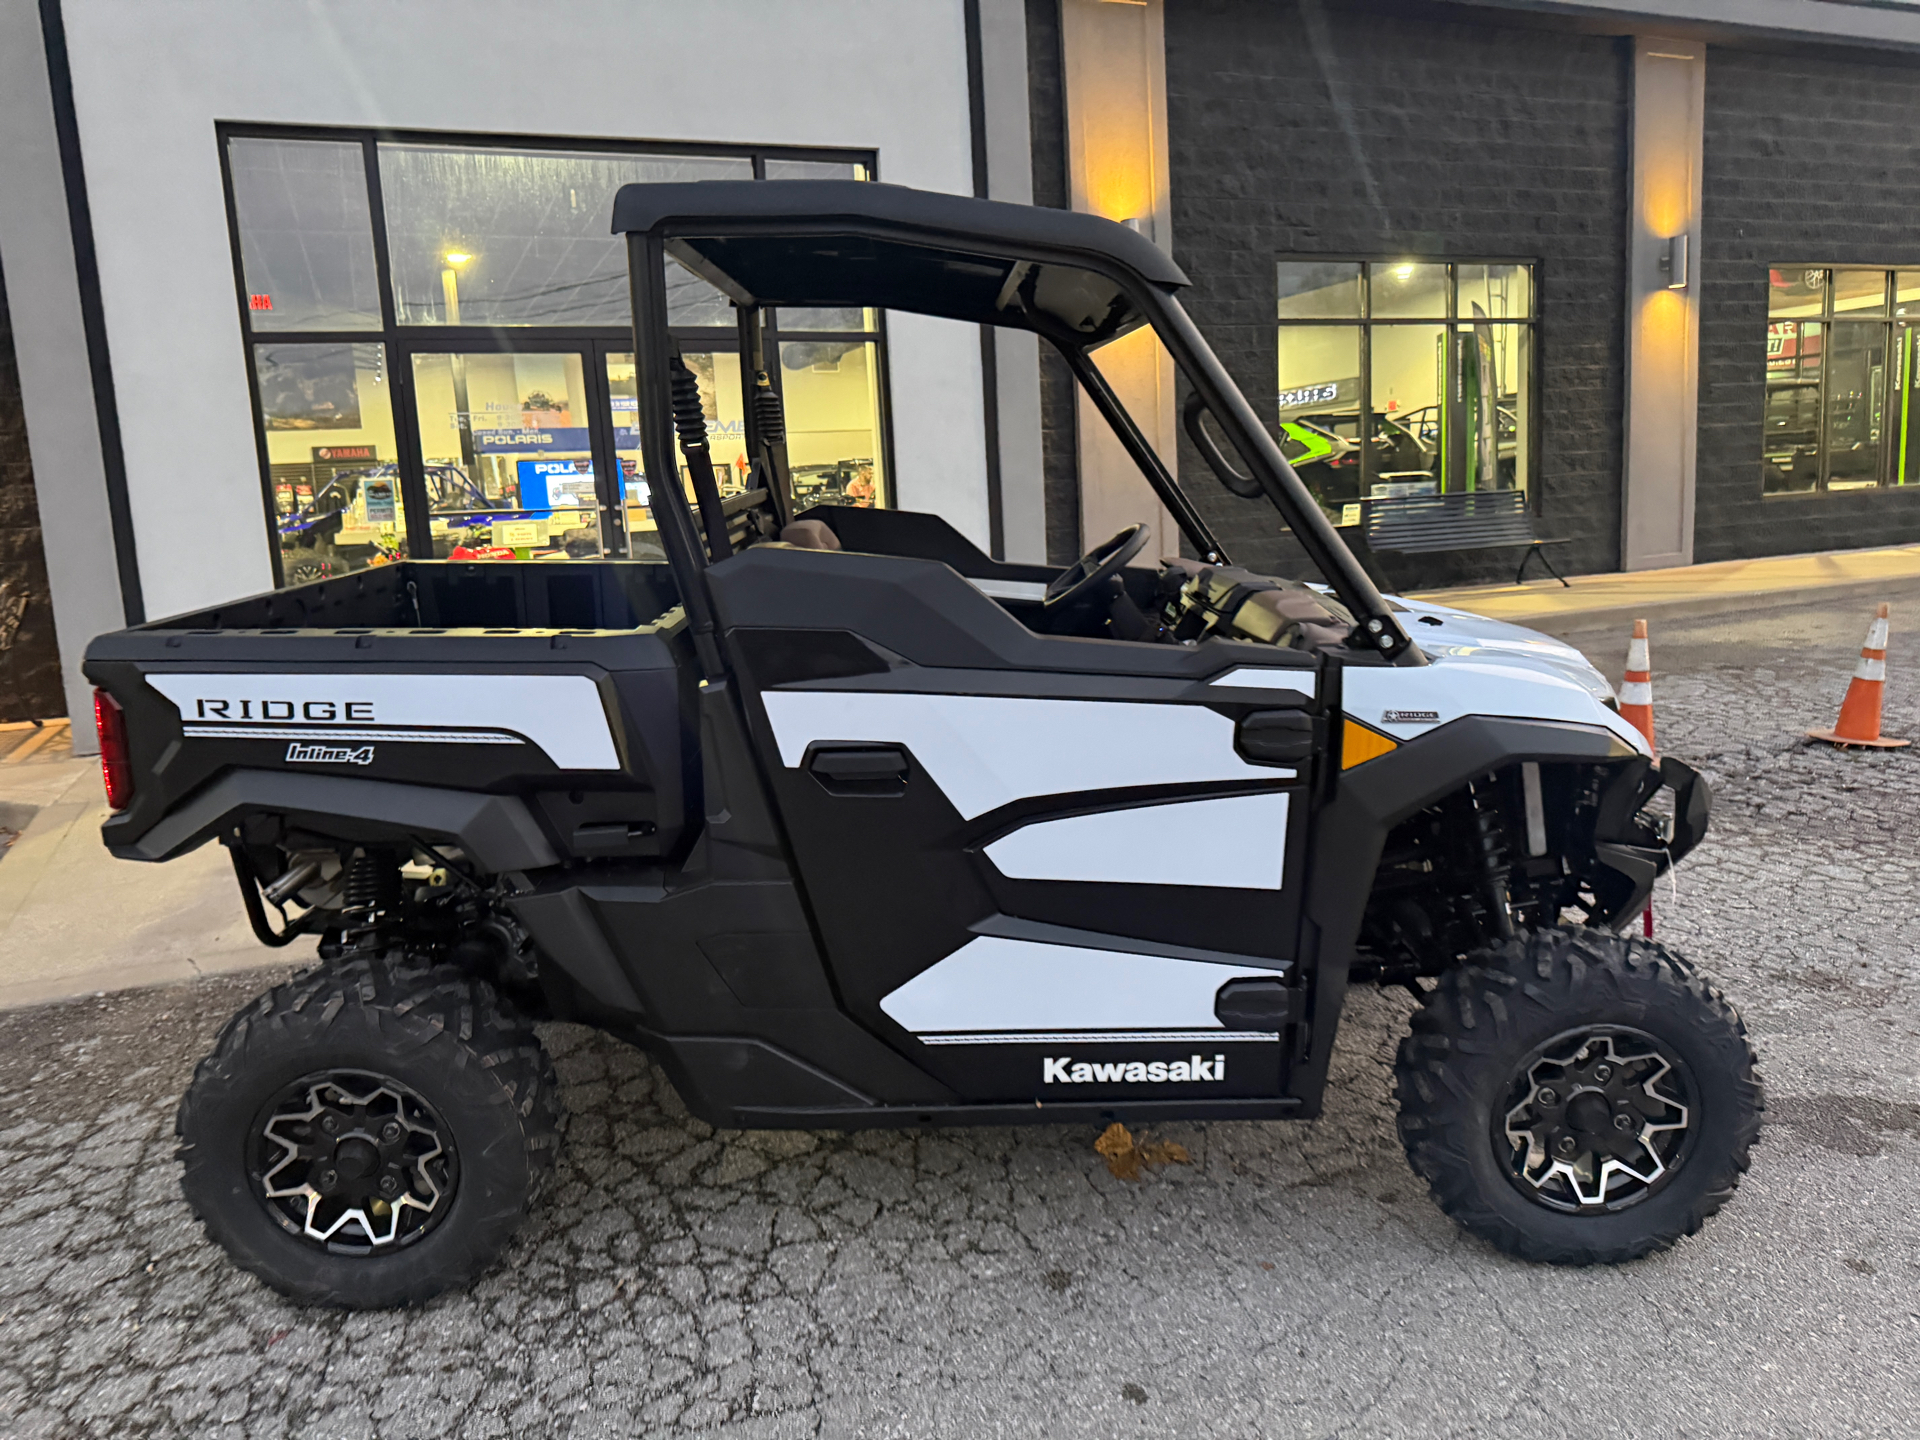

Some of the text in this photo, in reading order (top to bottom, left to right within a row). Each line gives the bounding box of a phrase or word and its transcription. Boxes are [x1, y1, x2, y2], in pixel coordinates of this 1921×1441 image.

[482, 434, 553, 445] POLARIS
[331, 447, 370, 458] YAMAHA
[196, 699, 375, 721] RIDGE
[285, 743, 375, 765] Inline-4
[1043, 1054, 1226, 1084] Kawasaki
